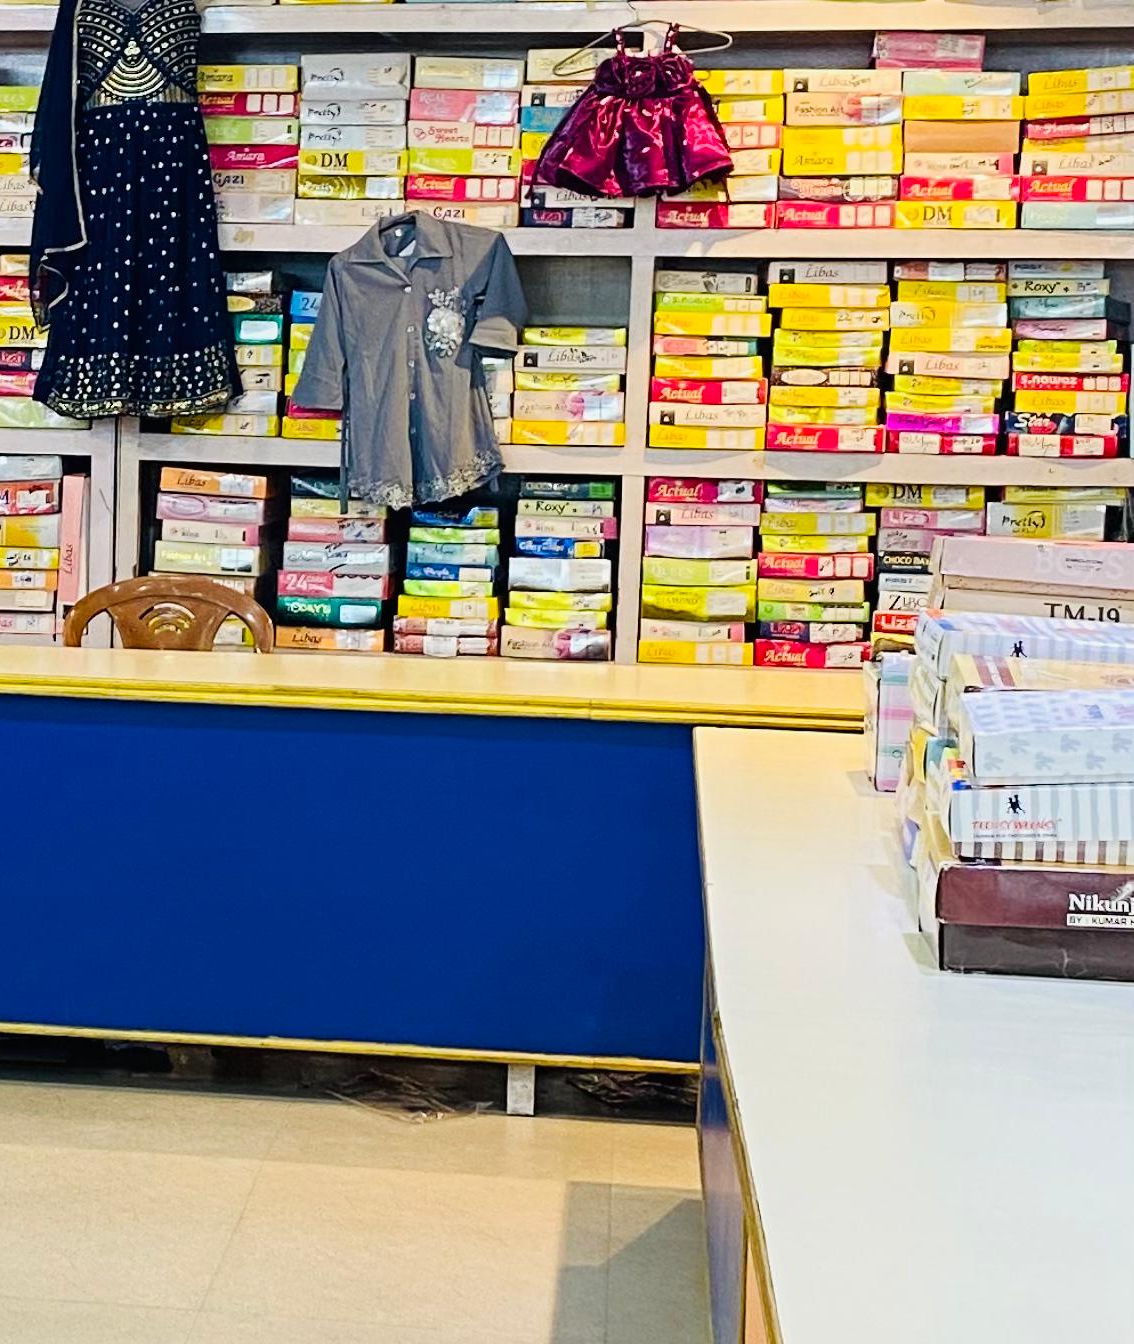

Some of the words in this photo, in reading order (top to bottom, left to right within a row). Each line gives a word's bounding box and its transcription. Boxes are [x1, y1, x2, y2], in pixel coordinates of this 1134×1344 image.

[320, 153, 349, 168] DM
[212, 172, 245, 187] GAZI
[433, 206, 466, 220] GAZI
[922, 206, 953, 222] DM
[804, 266, 840, 278] Libas
[1024, 280, 1057, 294] Roxy
[8, 325, 36, 341] DM
[891, 484, 922, 500] DM
[535, 501, 566, 515] Roxy
[286, 573, 307, 590] 24
[764, 649, 808, 664] Actual
[1069, 915, 1083, 924] BY
[1091, 916, 1128, 926] KUMAR
